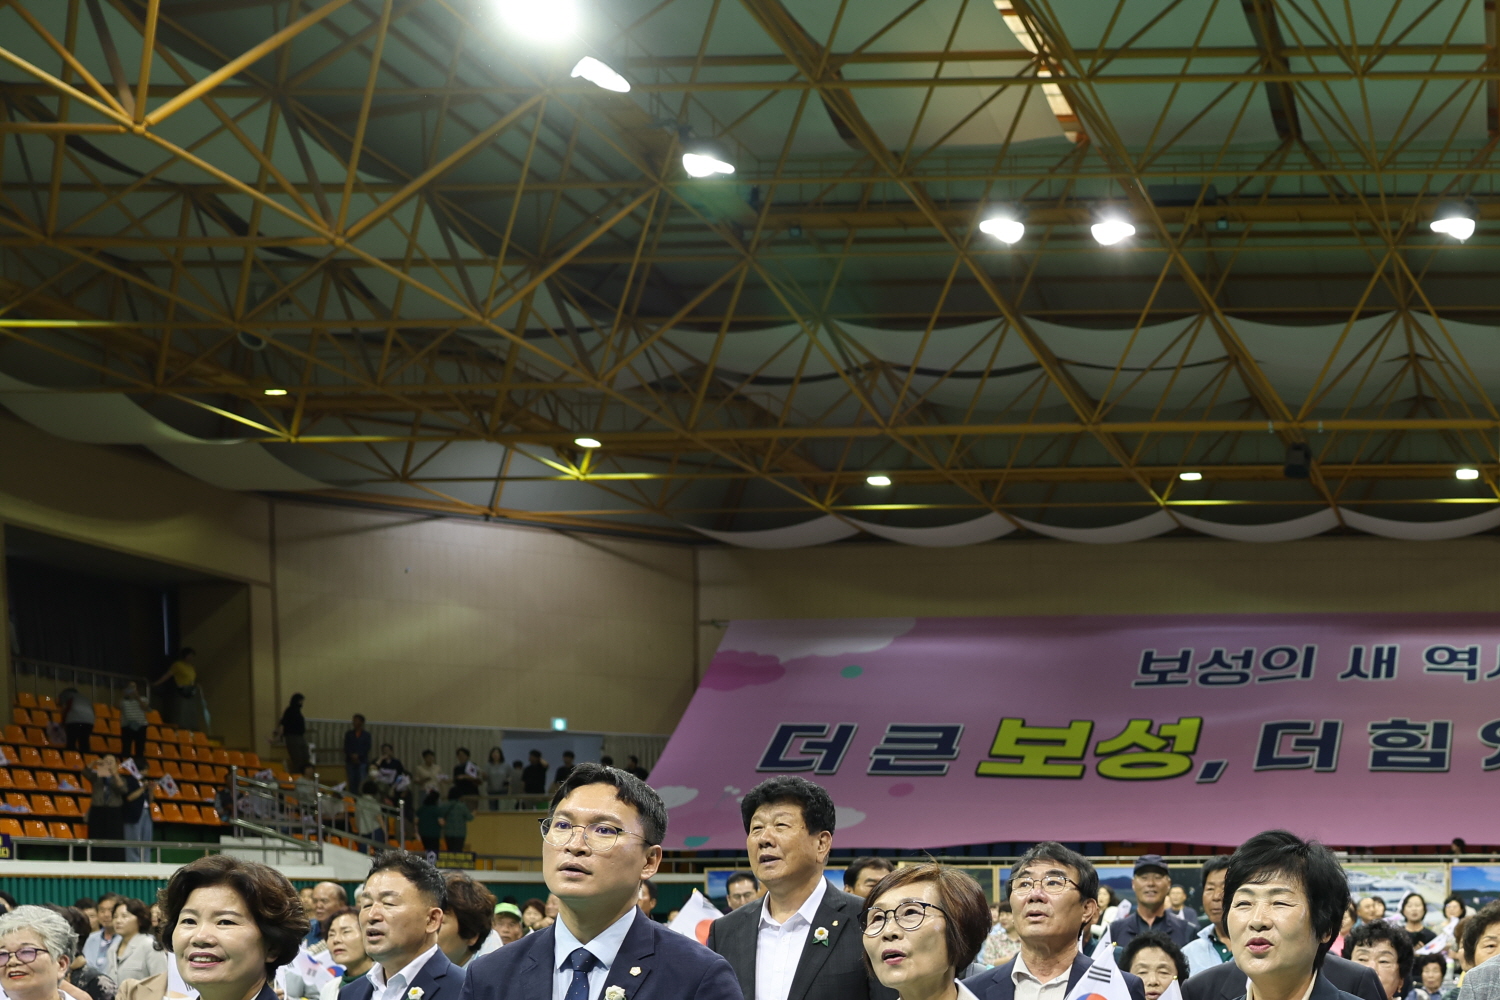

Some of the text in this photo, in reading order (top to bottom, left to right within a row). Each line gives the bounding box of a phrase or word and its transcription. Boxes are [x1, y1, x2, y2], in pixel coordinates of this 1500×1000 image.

[1132, 644, 1318, 688] 보성의
[1338, 643, 1400, 681] 새
[755, 721, 859, 774] 더
[866, 722, 965, 775] 큰
[974, 716, 1229, 783] 보성,
[1252, 719, 1345, 773] 더
[1366, 717, 1454, 773] 힘
